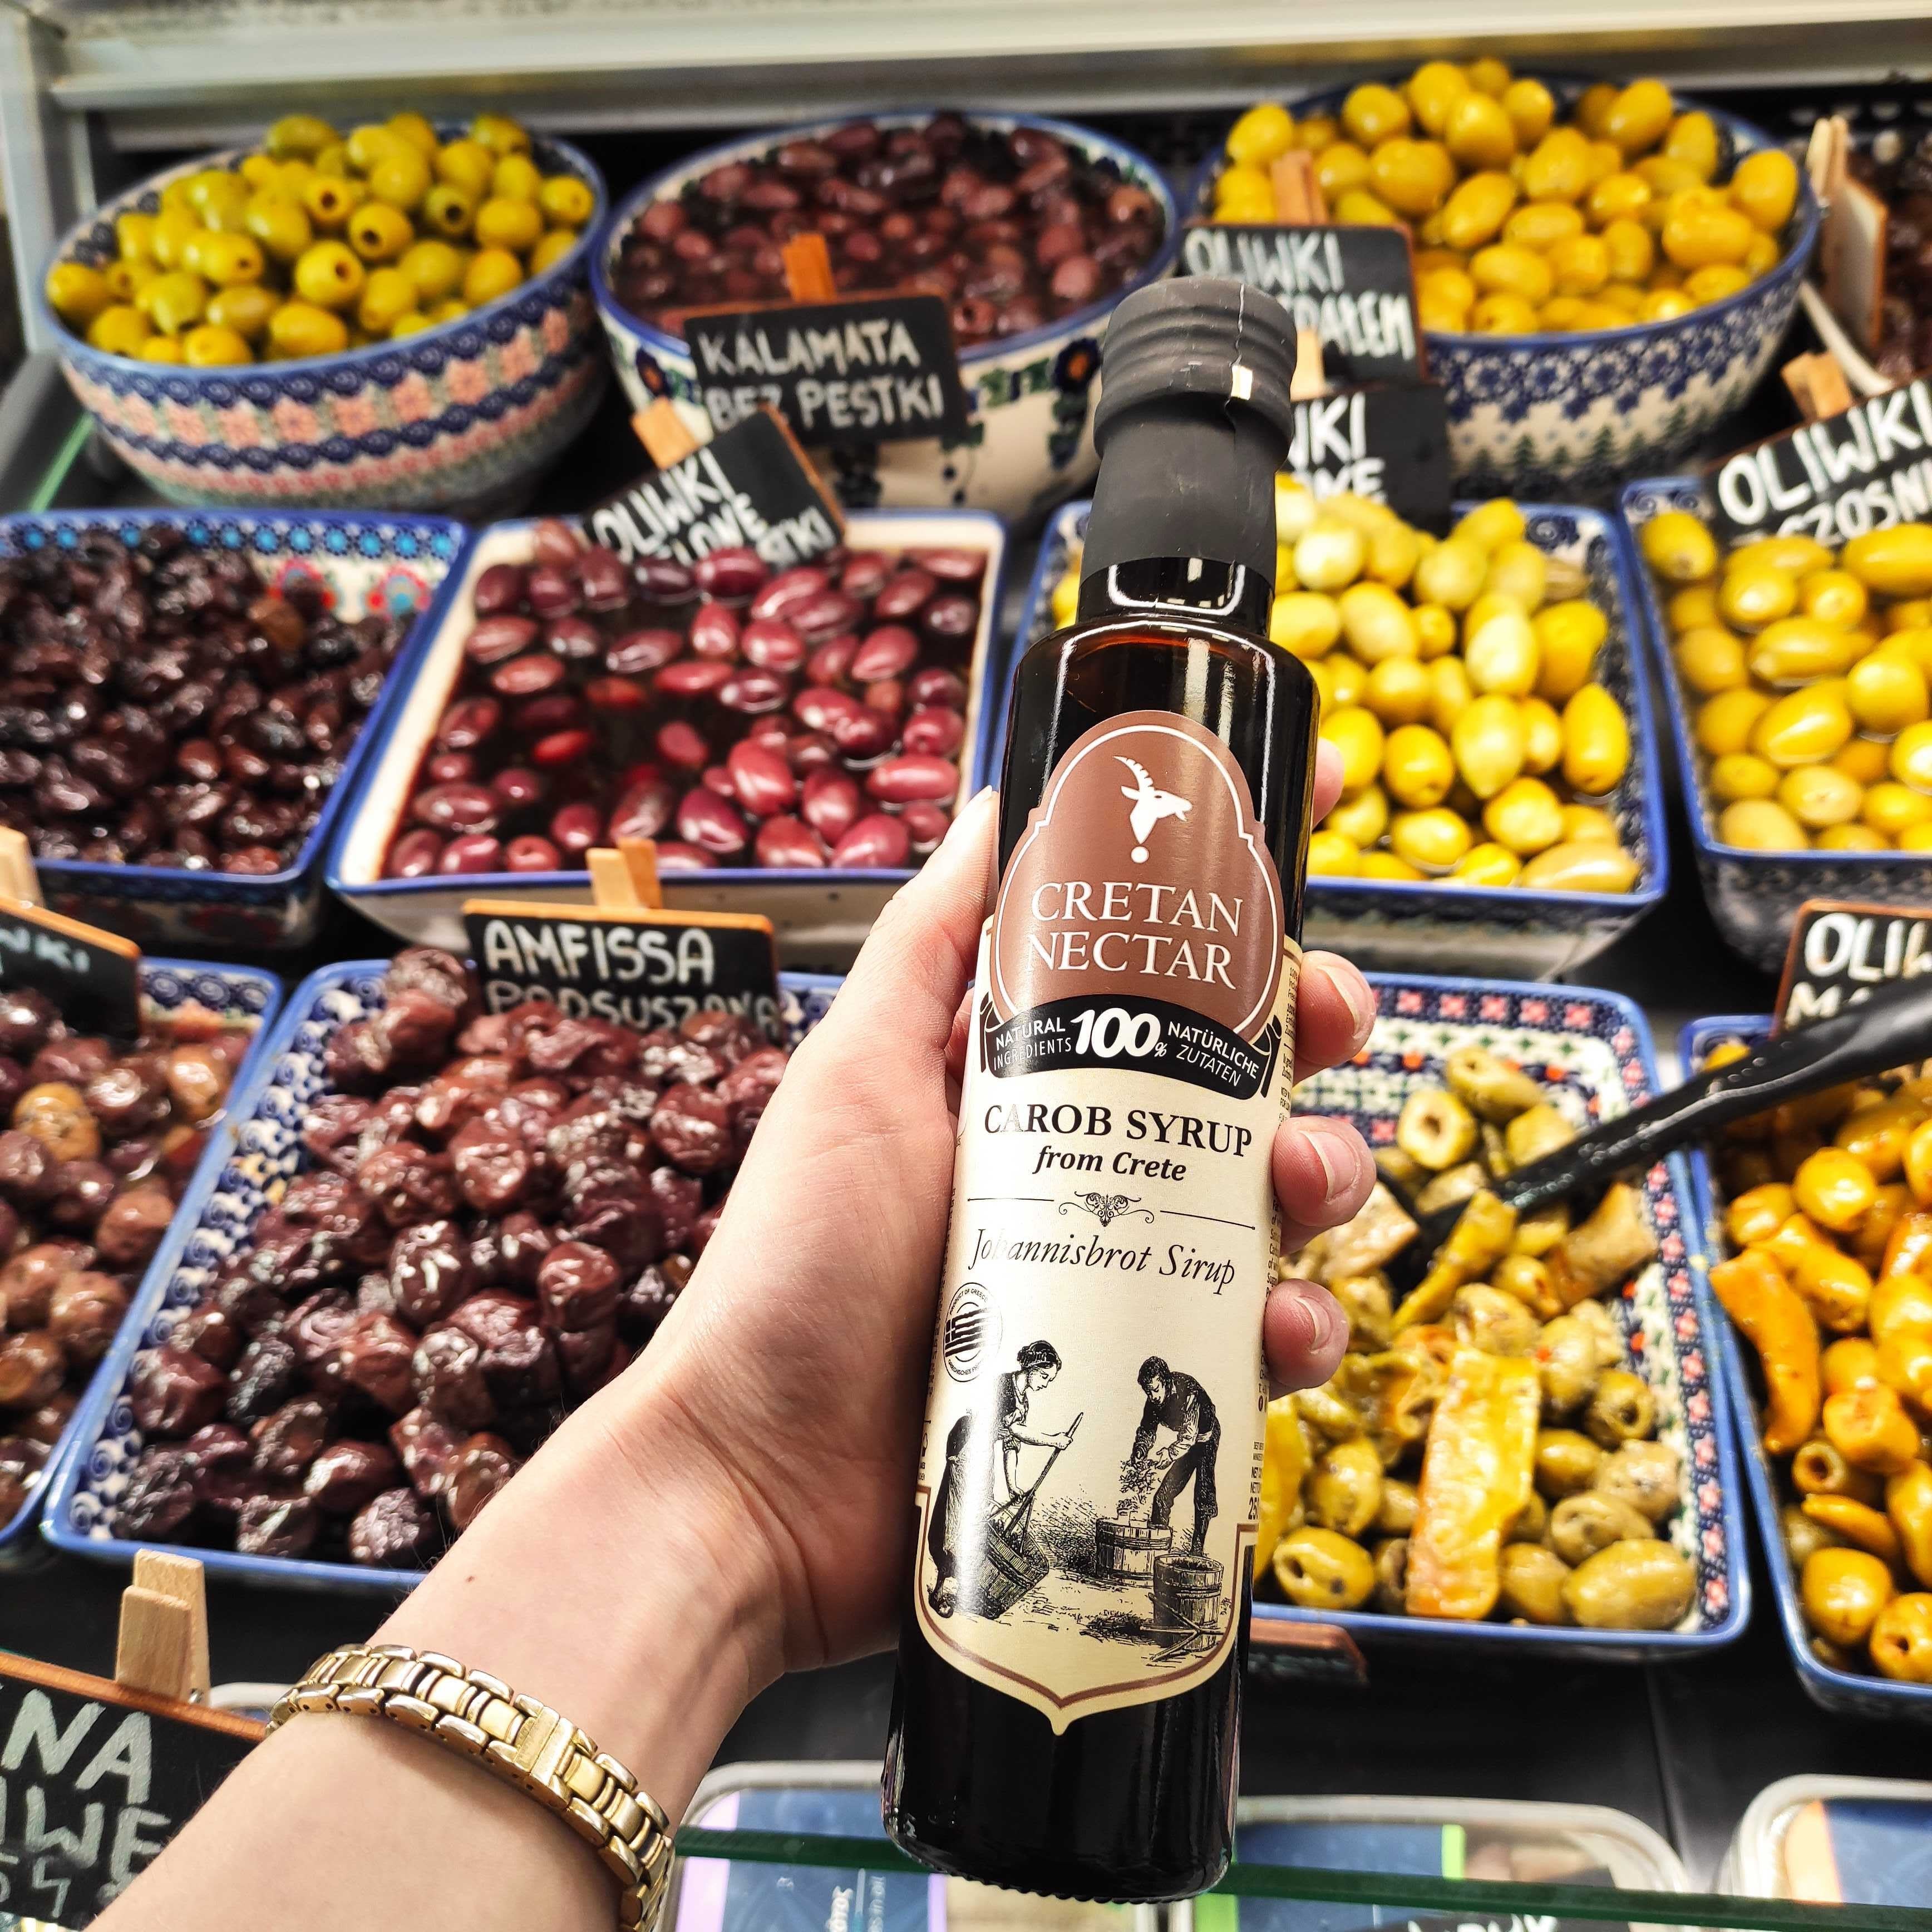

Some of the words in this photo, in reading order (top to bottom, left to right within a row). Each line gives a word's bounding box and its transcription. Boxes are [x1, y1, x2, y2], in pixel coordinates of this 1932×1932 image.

[698, 319, 920, 376] KALAMATA
[795, 373, 944, 427] PESTKI
[592, 445, 736, 564] OLIWKI
[1031, 881, 1243, 937] CRETAN
[484, 919, 715, 985] AMFISSA
[1027, 931, 1236, 990] NECTAR
[993, 1037, 1072, 1071] INGREDIENTS
[996, 1017, 1066, 1051] NATURAL
[1168, 1021, 1260, 1080] NATÜRLICHE
[1176, 1044, 1241, 1087] ZUTATEN
[984, 1104, 1112, 1136] CAROB
[1126, 1111, 1253, 1157] SYRUP
[1032, 1145, 1103, 1175] from
[1113, 1151, 1187, 1181] Crete
[1159, 1244, 1235, 1295] Sirup
